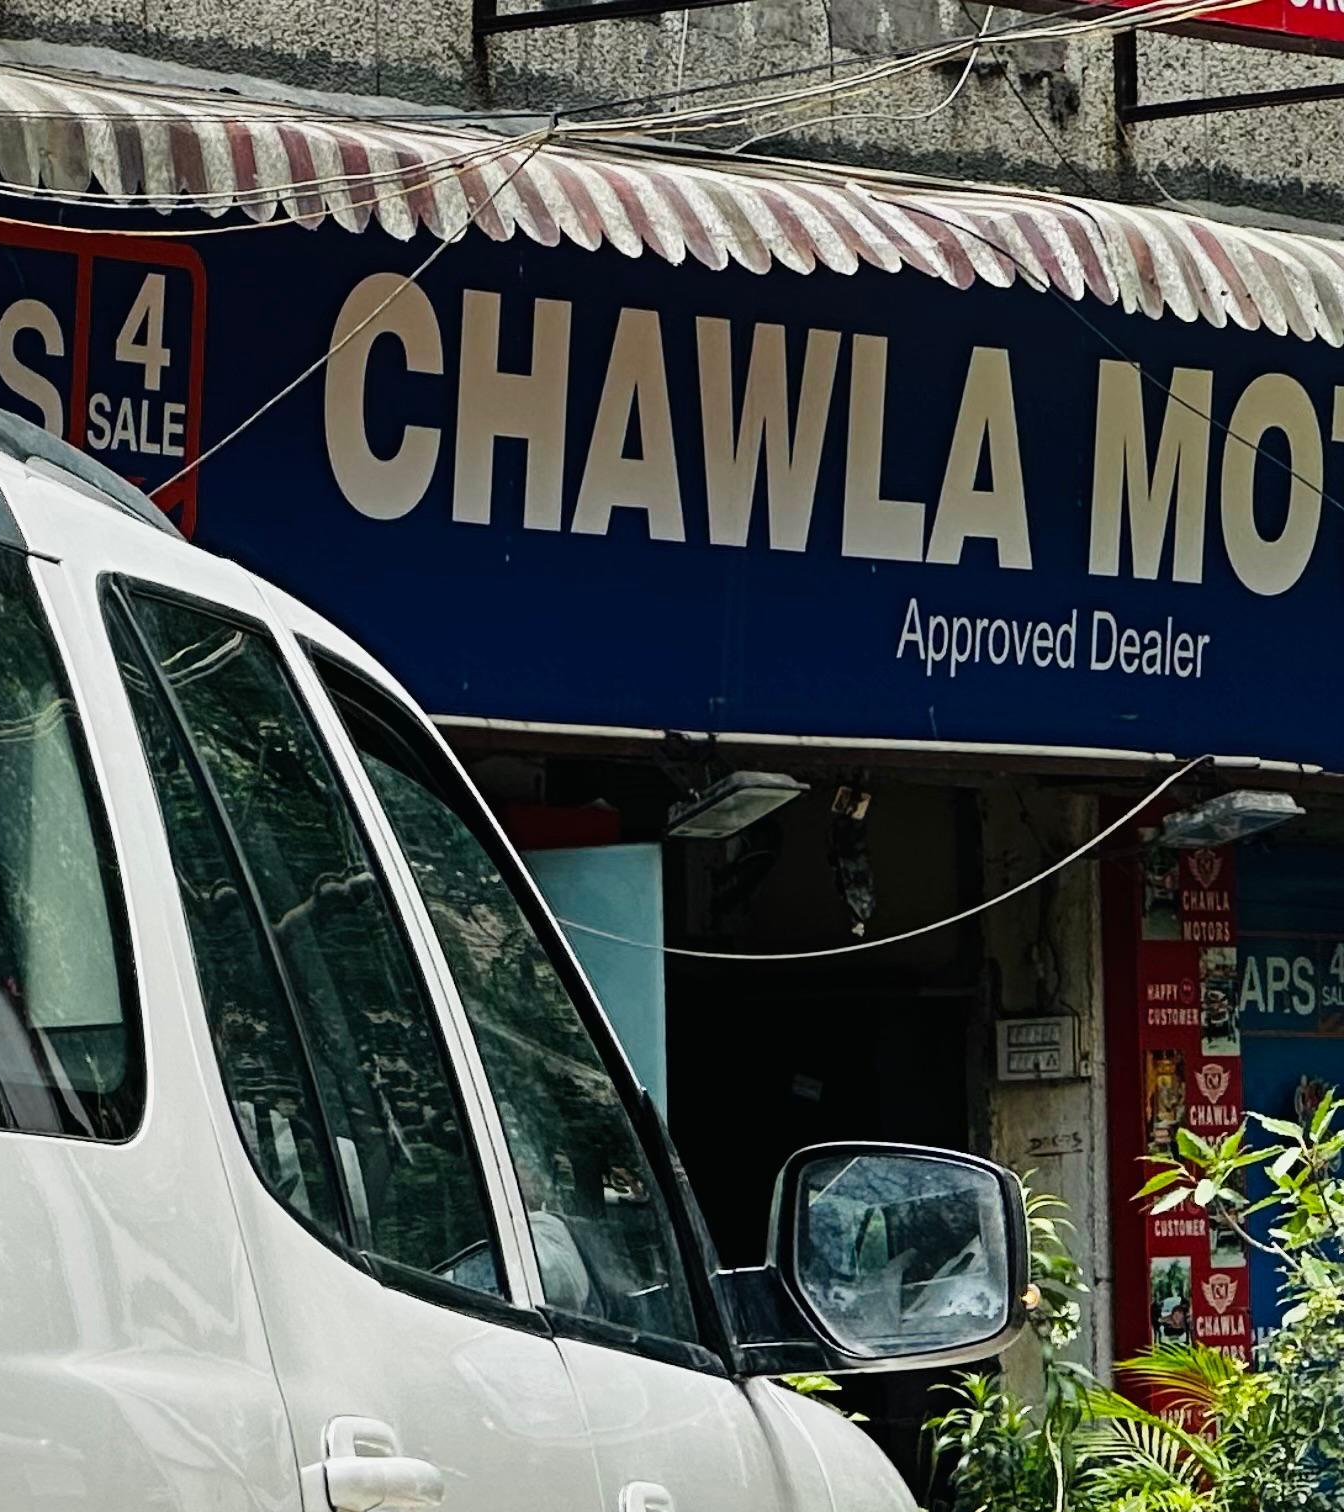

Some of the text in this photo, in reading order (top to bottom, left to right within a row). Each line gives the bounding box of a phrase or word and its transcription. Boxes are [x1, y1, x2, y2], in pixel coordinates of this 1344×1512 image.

[115, 273, 171, 391] 4
[87, 393, 186, 457] SALE
[324, 272, 1344, 597] CHAWLA MO
[897, 597, 1211, 679] Approved Dealer
[1183, 890, 1230, 911] CHAWLA
[1183, 921, 1230, 941] MOTORS
[1147, 984, 1178, 1000] HAPPY
[1147, 1008, 1200, 1025] CUSTOMER
[1190, 1105, 1238, 1126] CHAWLA
[1154, 1219, 1206, 1237] CUSTOMER
[1196, 1315, 1245, 1337] CHAWLA
